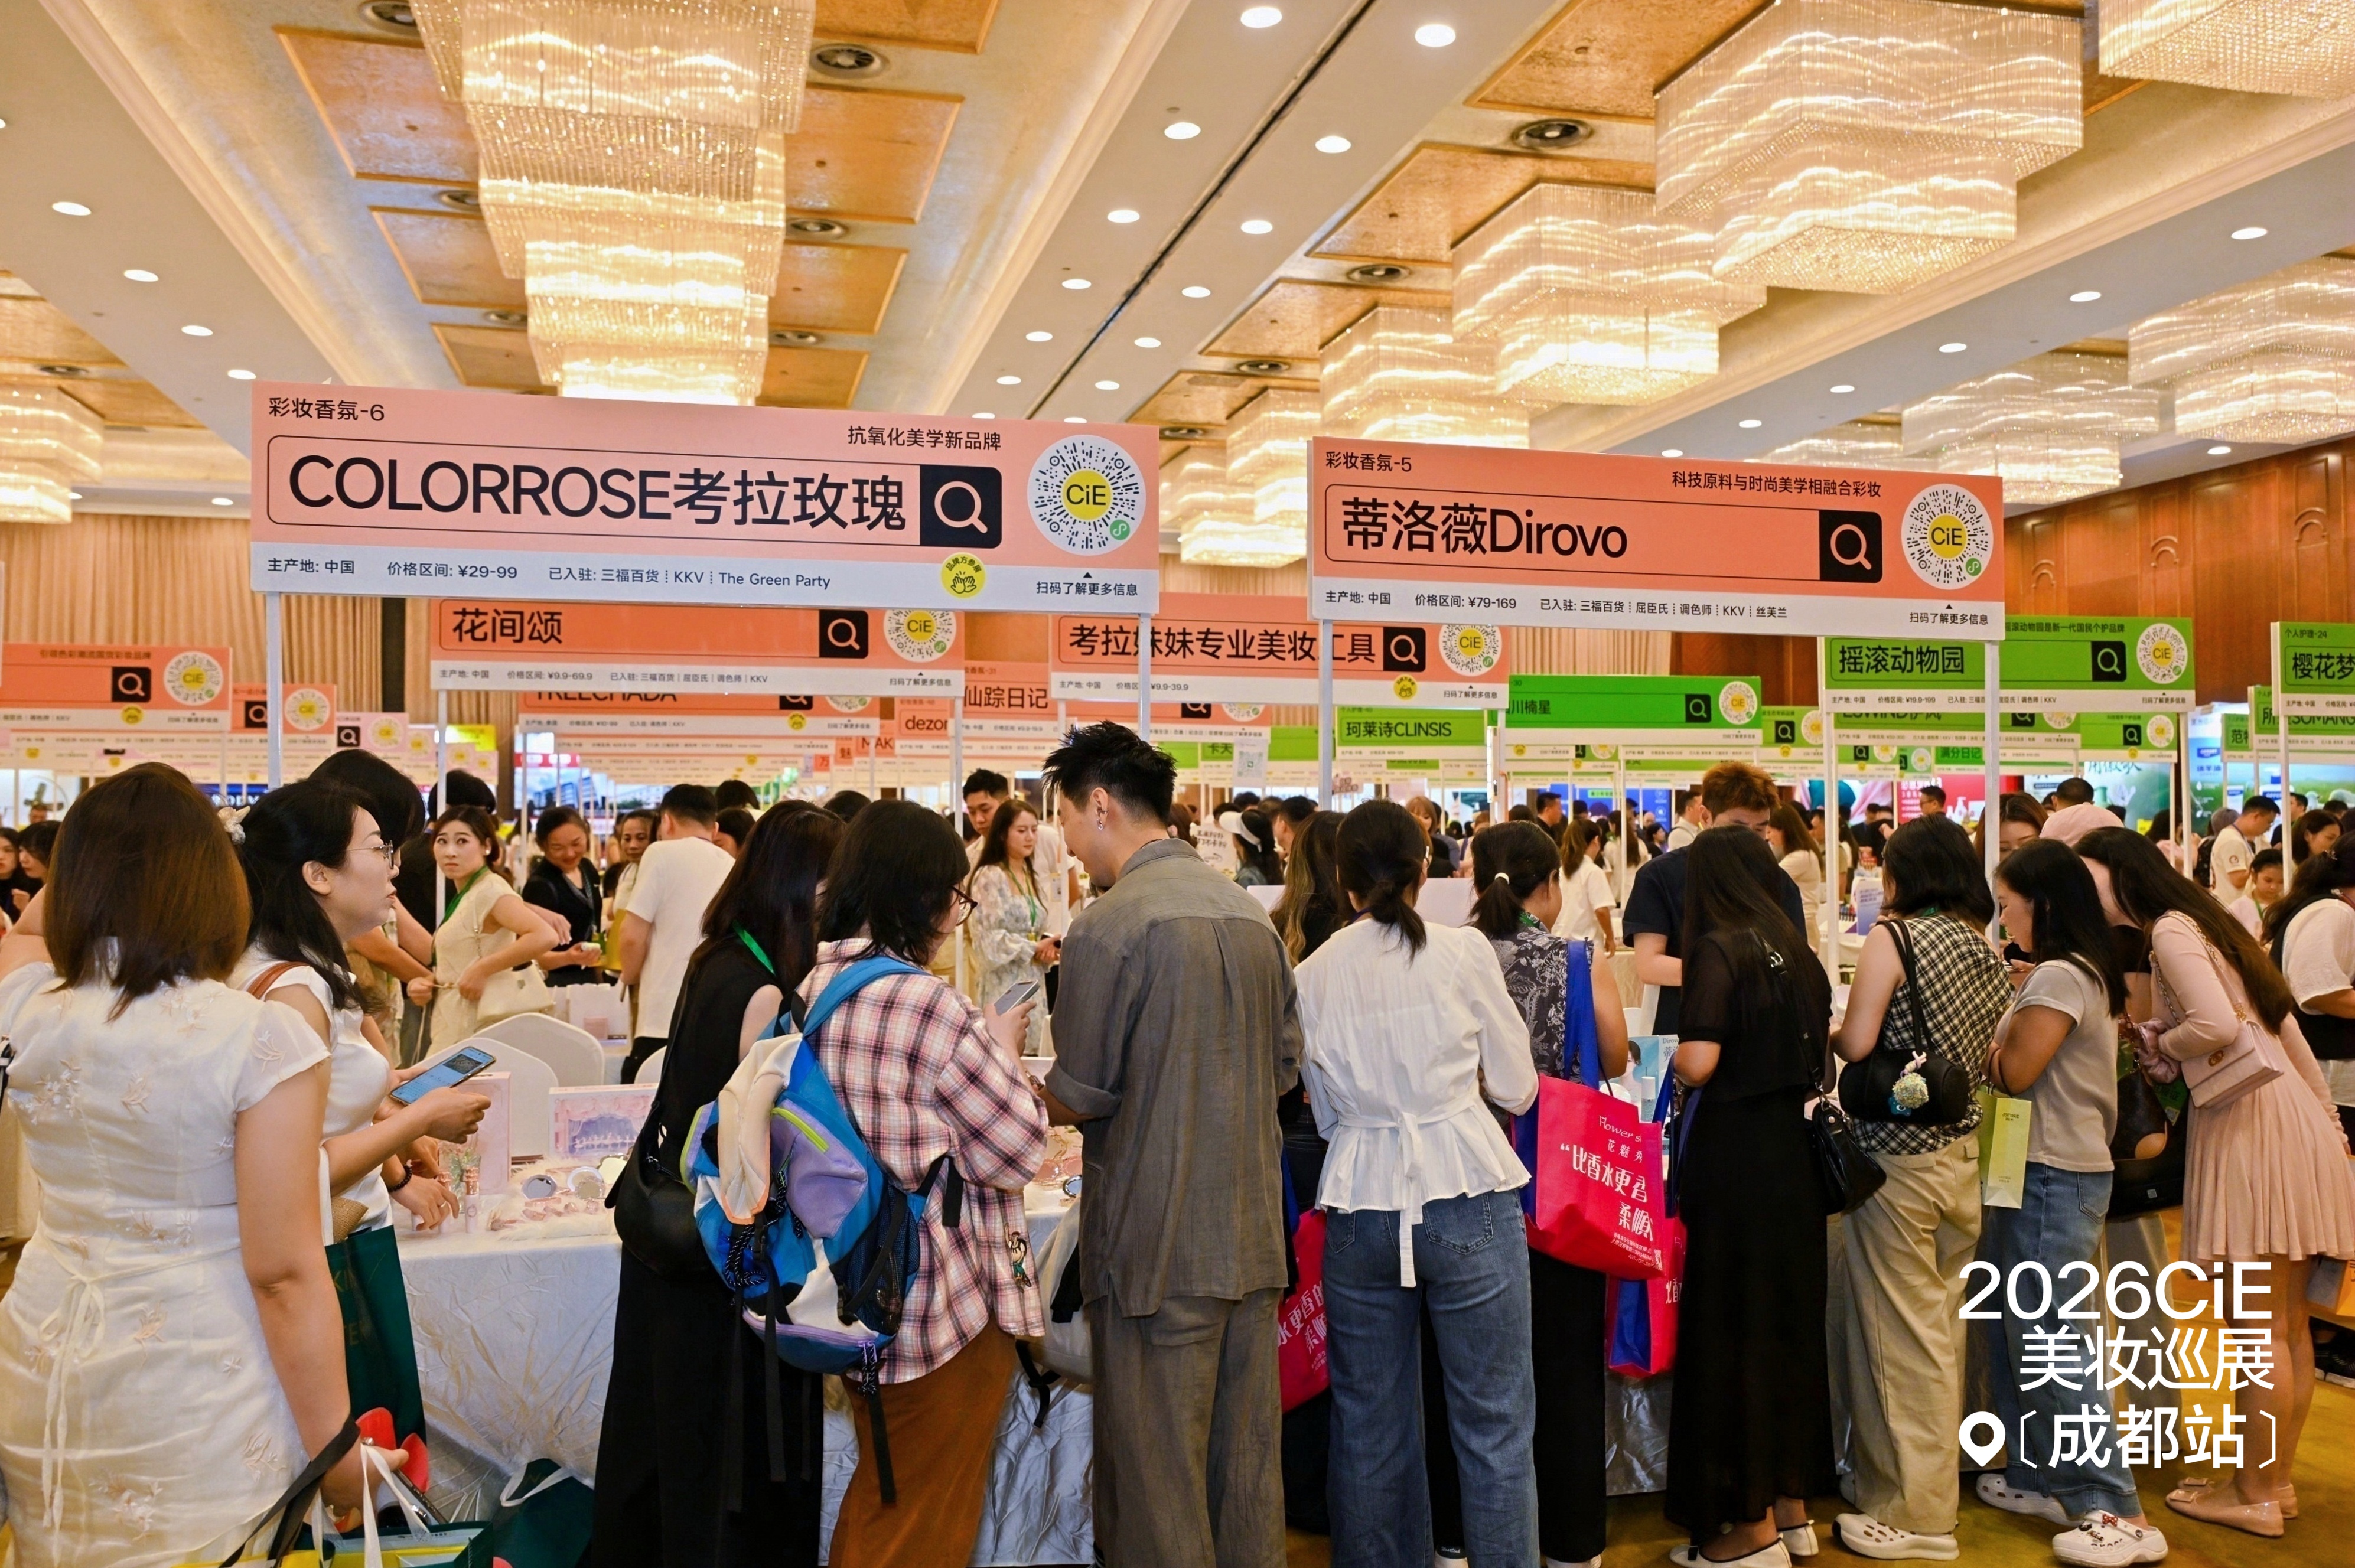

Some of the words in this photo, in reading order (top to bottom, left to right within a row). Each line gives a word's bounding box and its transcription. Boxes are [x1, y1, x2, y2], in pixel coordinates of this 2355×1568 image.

[269, 397, 385, 422] 彩妆香氛-6
[848, 425, 1001, 451] 抗氧化美学新品牌
[1325, 451, 1412, 472] 彩妆香氛-5
[289, 454, 907, 533] COLORROSE考拉玫瑰
[1066, 483, 1106, 506] CiE
[1672, 471, 1881, 498] 科技原料与时尚美学相融合彩妆
[1342, 497, 1627, 558] 蒂洛薇Dirovo
[1931, 527, 1963, 546] CiE
[268, 558, 319, 573] 主产地:
[325, 560, 354, 575] 中国
[387, 562, 452, 578] 价格区间:
[458, 565, 517, 579] ¥29-99
[549, 566, 596, 582] 已入驻:
[601, 568, 659, 583] 三福百货
[675, 571, 704, 583] KKV
[719, 572, 744, 586] The
[750, 573, 790, 587] Green
[796, 574, 830, 591] Party
[1036, 581, 1138, 596] 扫码了解更多信息
[1325, 591, 1364, 604] 主产地:
[1368, 592, 1390, 605] 中国
[1415, 594, 1465, 608] 价格区间:
[1468, 596, 1517, 609] ¥79-169
[1580, 600, 1624, 614] 三福百货
[1636, 602, 1669, 615] 屈臣氏
[1679, 604, 1712, 617] 调色师
[1723, 606, 1745, 617] KKV
[1756, 606, 1787, 618] 丝芙兰
[452, 608, 562, 644] 花间颂
[907, 620, 932, 633] CiE
[1910, 612, 1988, 625] 扫码了解更多信息
[1460, 637, 1481, 649] CiE
[2153, 648, 2171, 659] CiE
[1839, 644, 1965, 674] 摇滚动物园
[471, 670, 489, 679] 中国
[641, 673, 675, 682] 三福百货
[889, 677, 952, 686] 扫码了解更多信息
[1086, 681, 1101, 689] 中国
[1116, 682, 1139, 690] 价格区
[1444, 690, 1498, 699] 扫码了解更多信息
[1599, 1115, 1633, 1139] Flower
